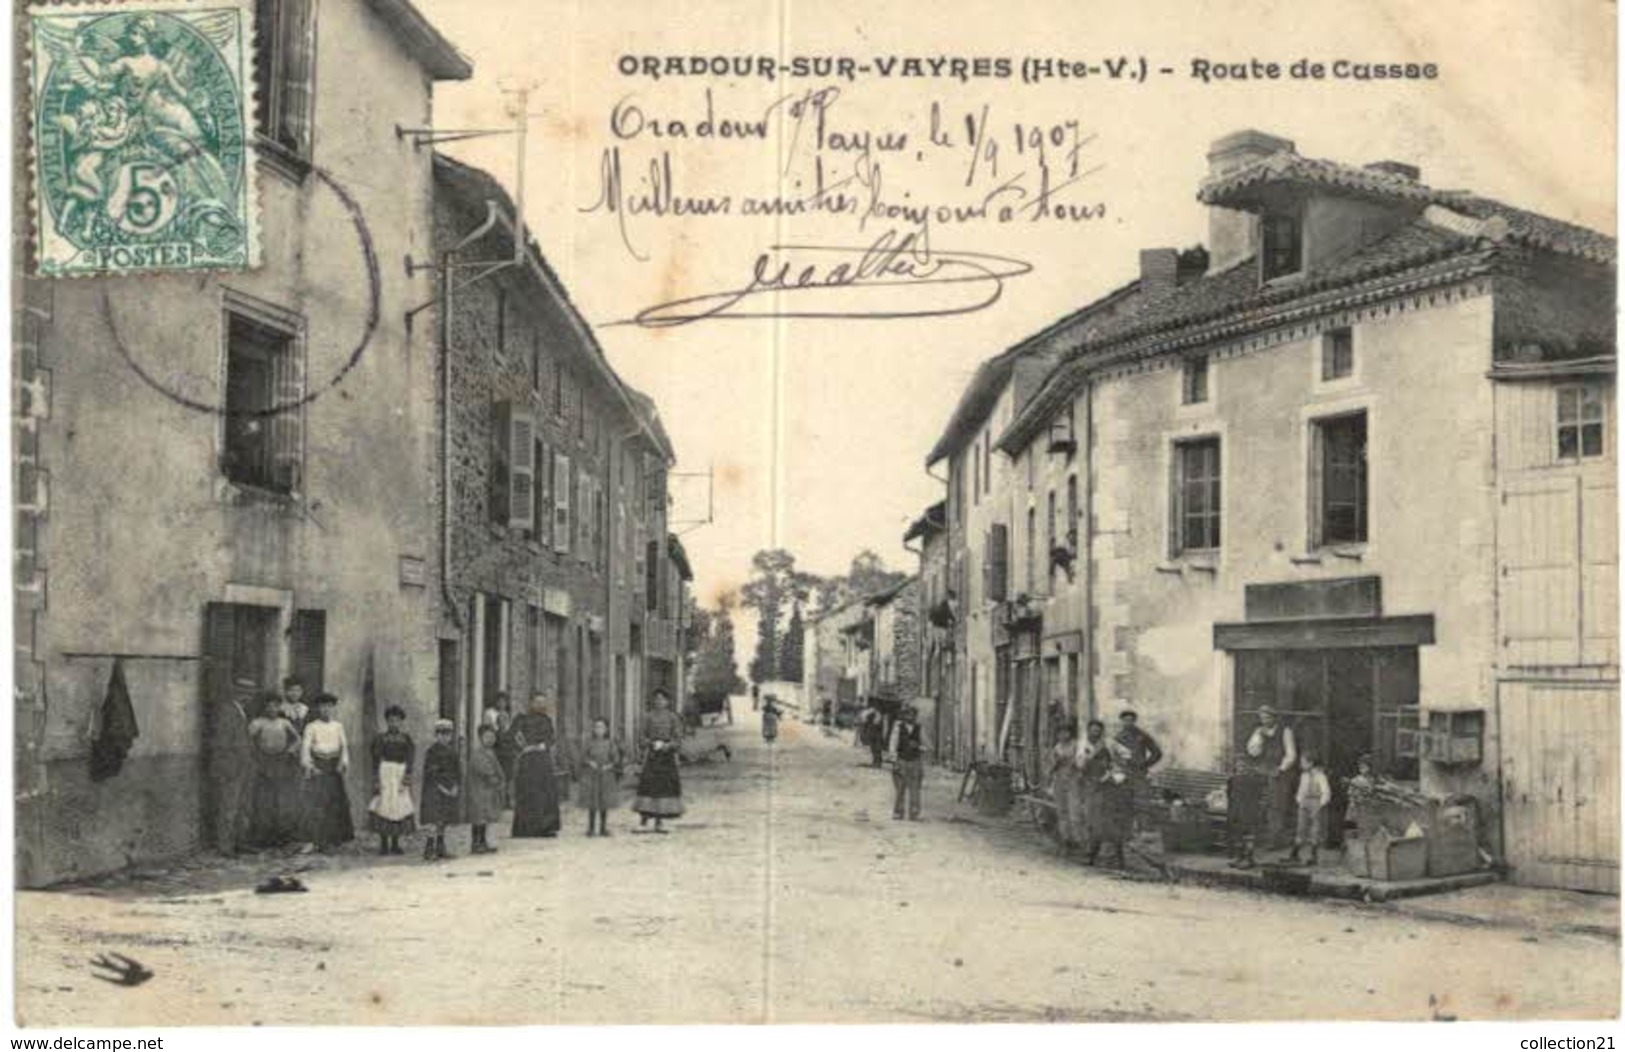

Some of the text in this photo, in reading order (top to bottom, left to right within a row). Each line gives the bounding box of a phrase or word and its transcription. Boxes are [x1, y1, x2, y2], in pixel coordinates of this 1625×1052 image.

[610, 87, 791, 140] Oradour
[1014, 118, 1094, 178] 1907
[100, 246, 189, 269] POSTES
